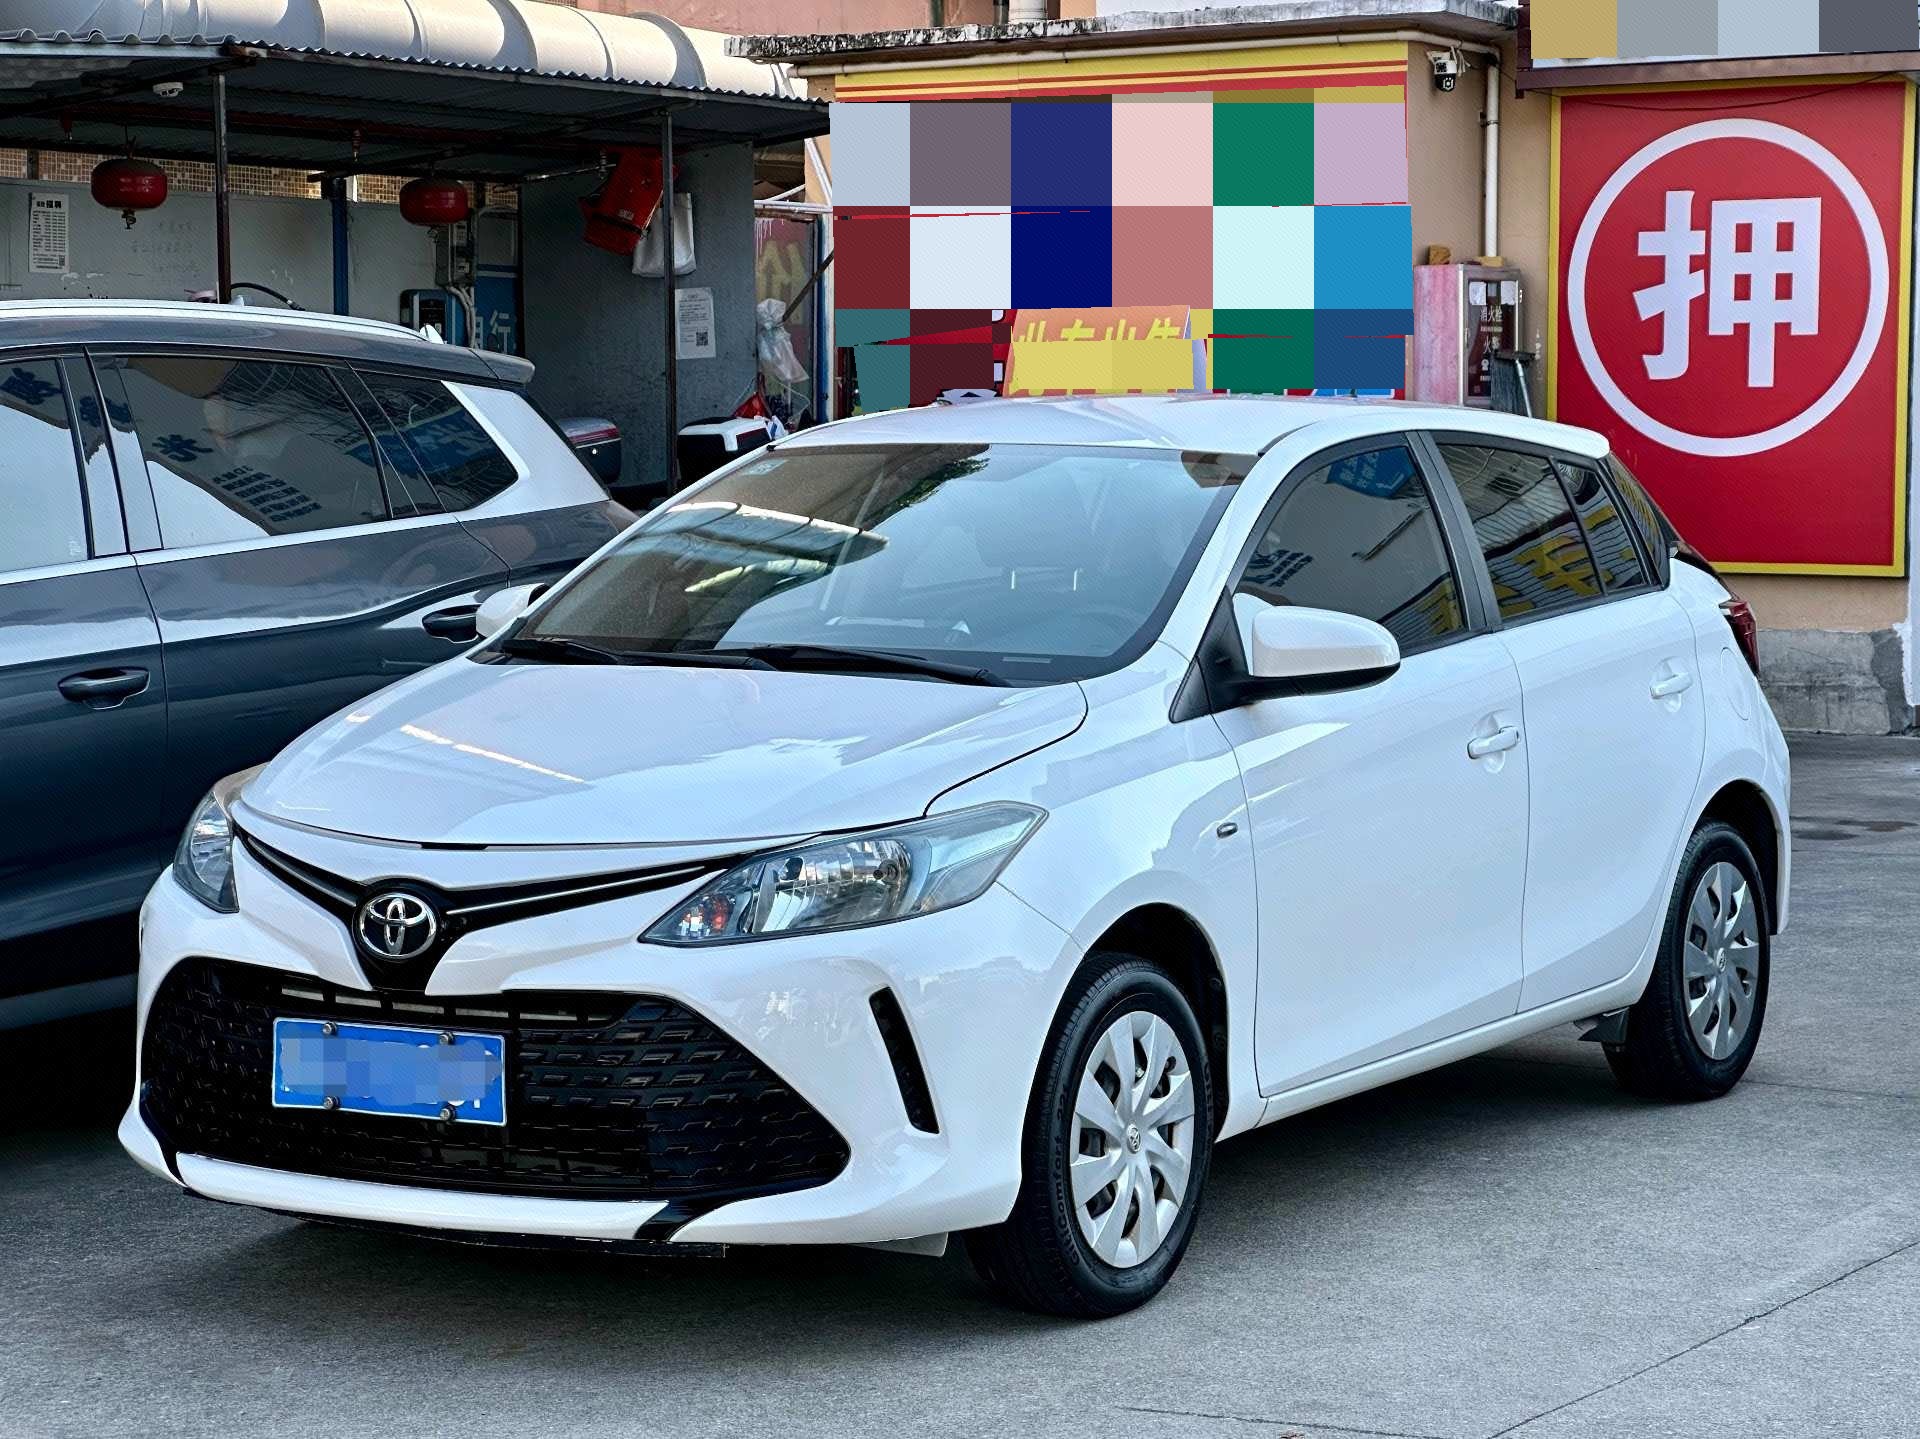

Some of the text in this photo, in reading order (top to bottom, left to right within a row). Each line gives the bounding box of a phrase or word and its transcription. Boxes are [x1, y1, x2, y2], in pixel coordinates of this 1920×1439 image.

[1480, 305, 1503, 322] 消火栓
[1633, 190, 1822, 388] 押
